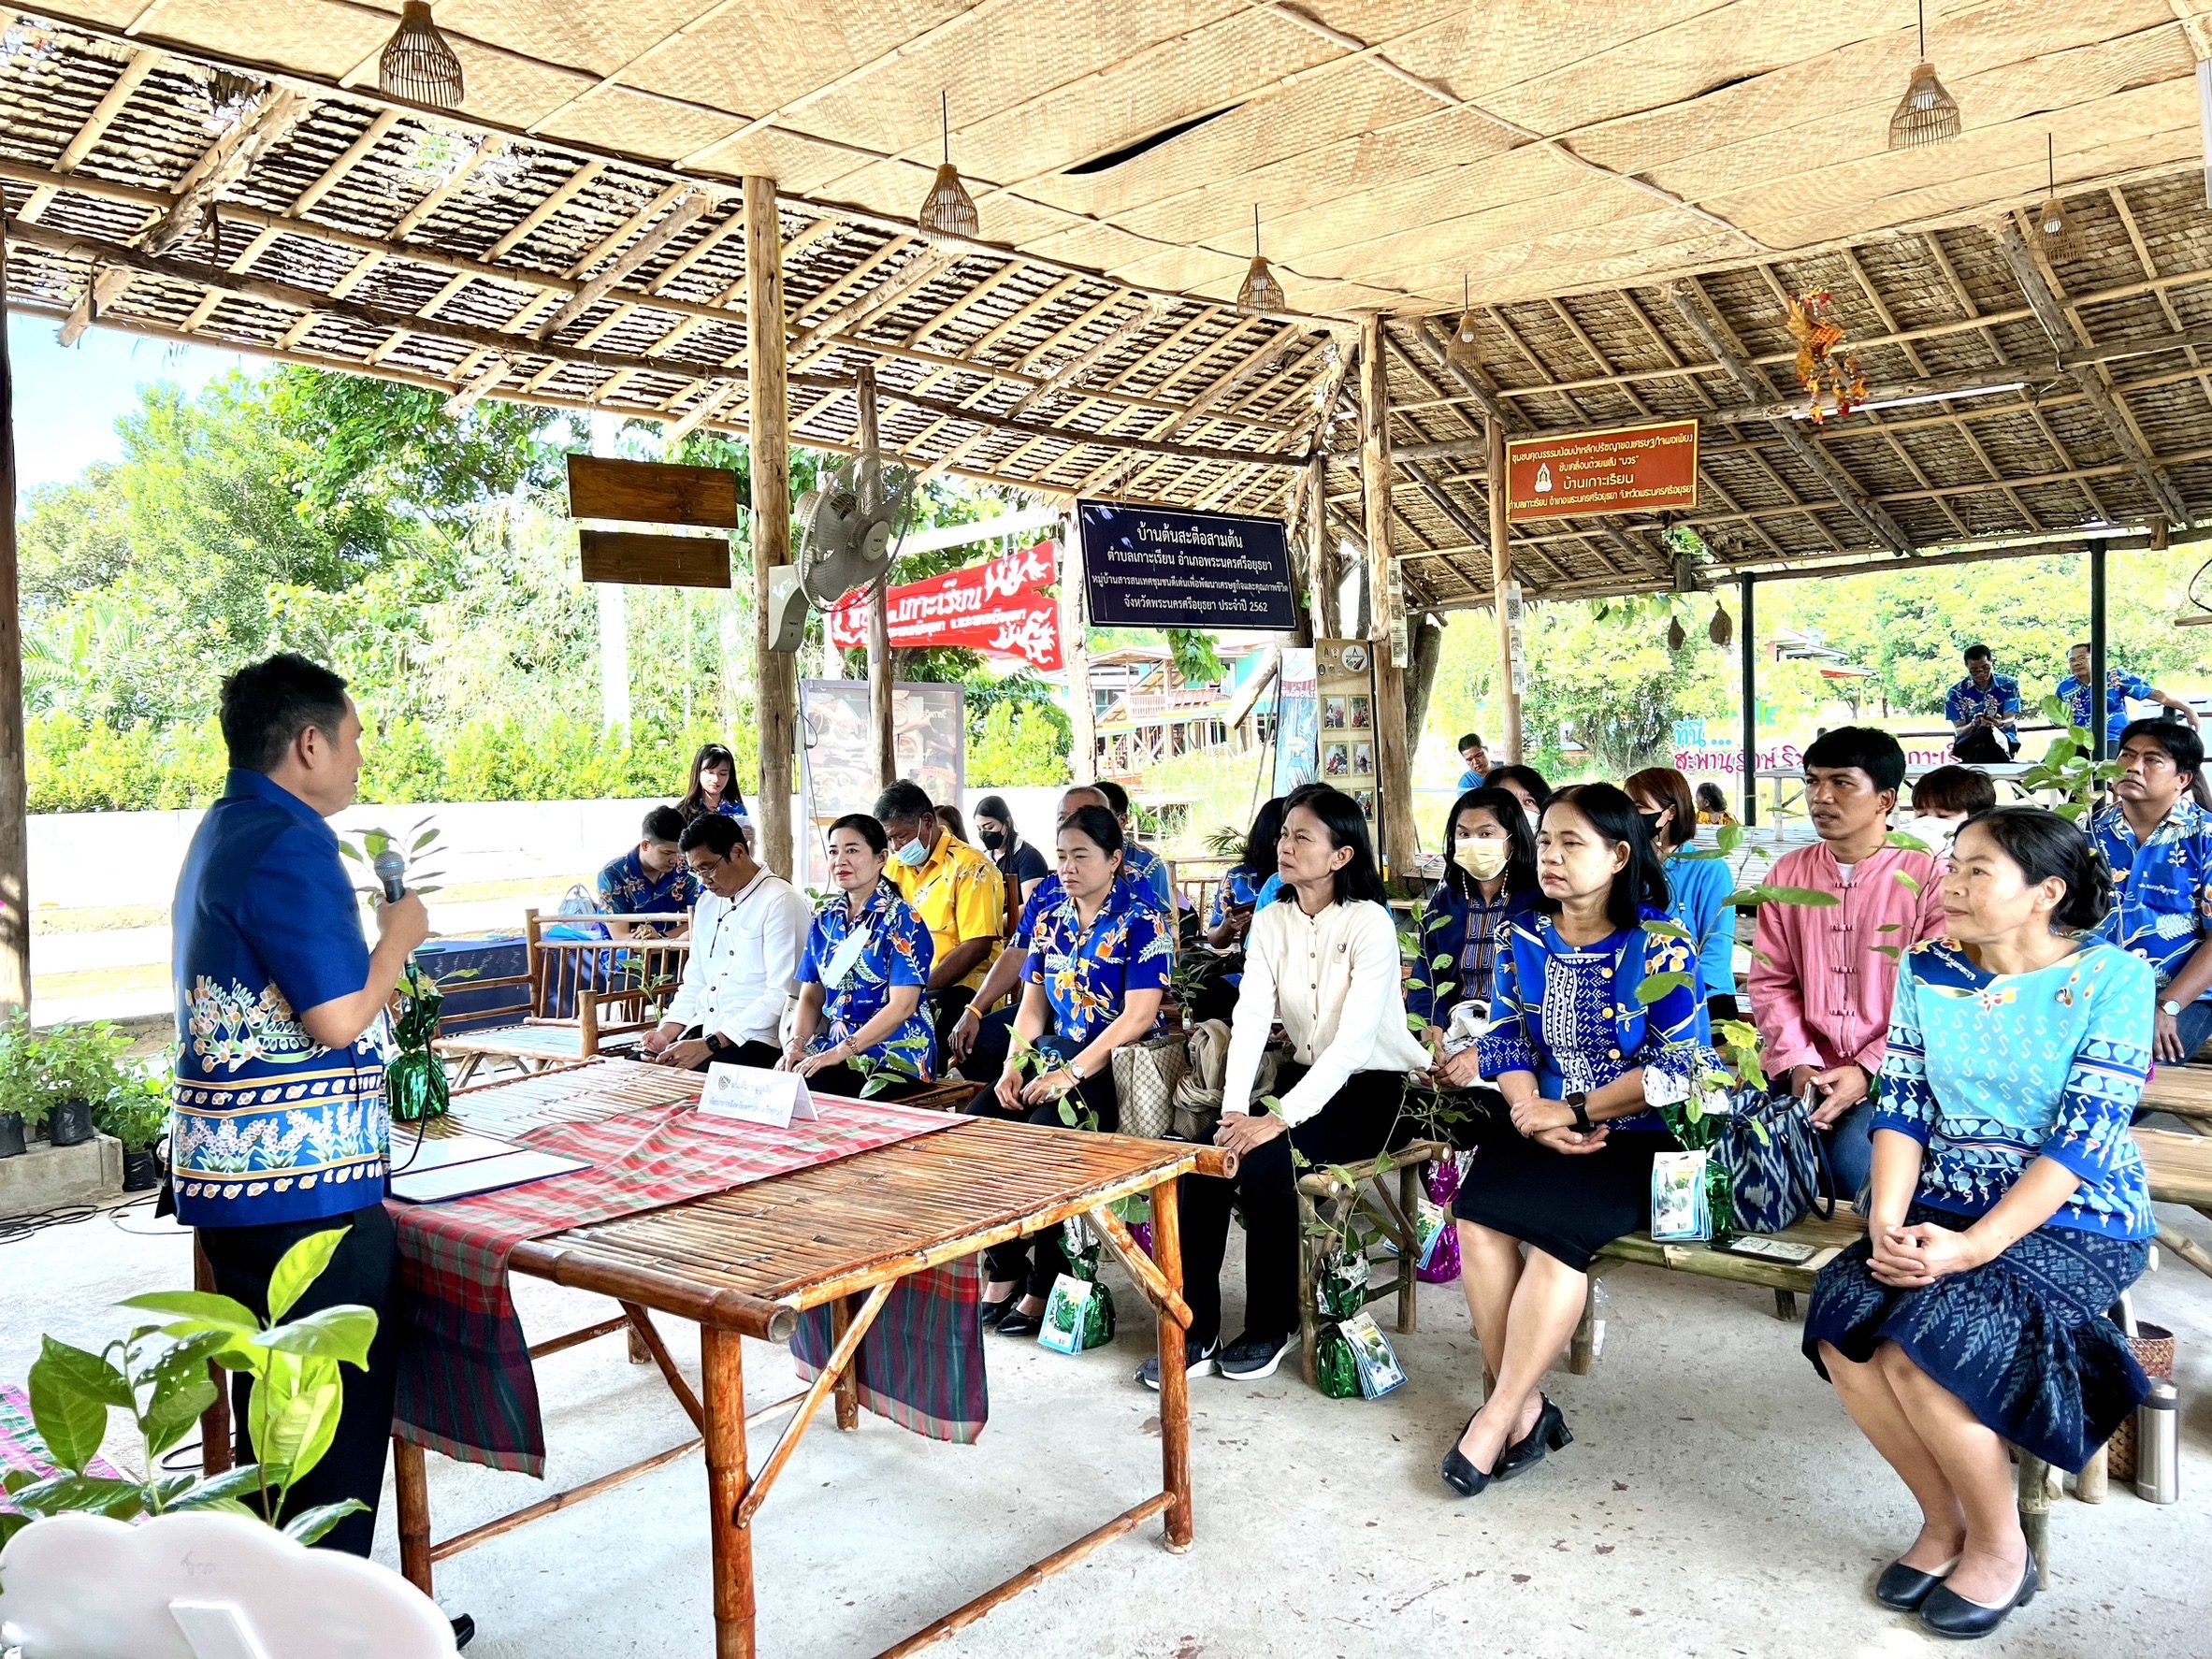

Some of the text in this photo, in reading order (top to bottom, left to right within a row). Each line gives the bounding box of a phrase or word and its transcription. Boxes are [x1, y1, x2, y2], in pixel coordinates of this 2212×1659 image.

[1563, 472, 1635, 491] บ้านเกาะเรียน
[1136, 520, 1244, 550] บ้านต้นสะตือสามต้น
[1106, 549, 1273, 575] ตำบลเกาะเรียน อำเภอพระนครศรีอยุธยา
[1123, 594, 1268, 614] จังหวัดพระนครศรีอยุธยา ประจำปี 2562
[1673, 716, 1707, 747] ที่นี่
